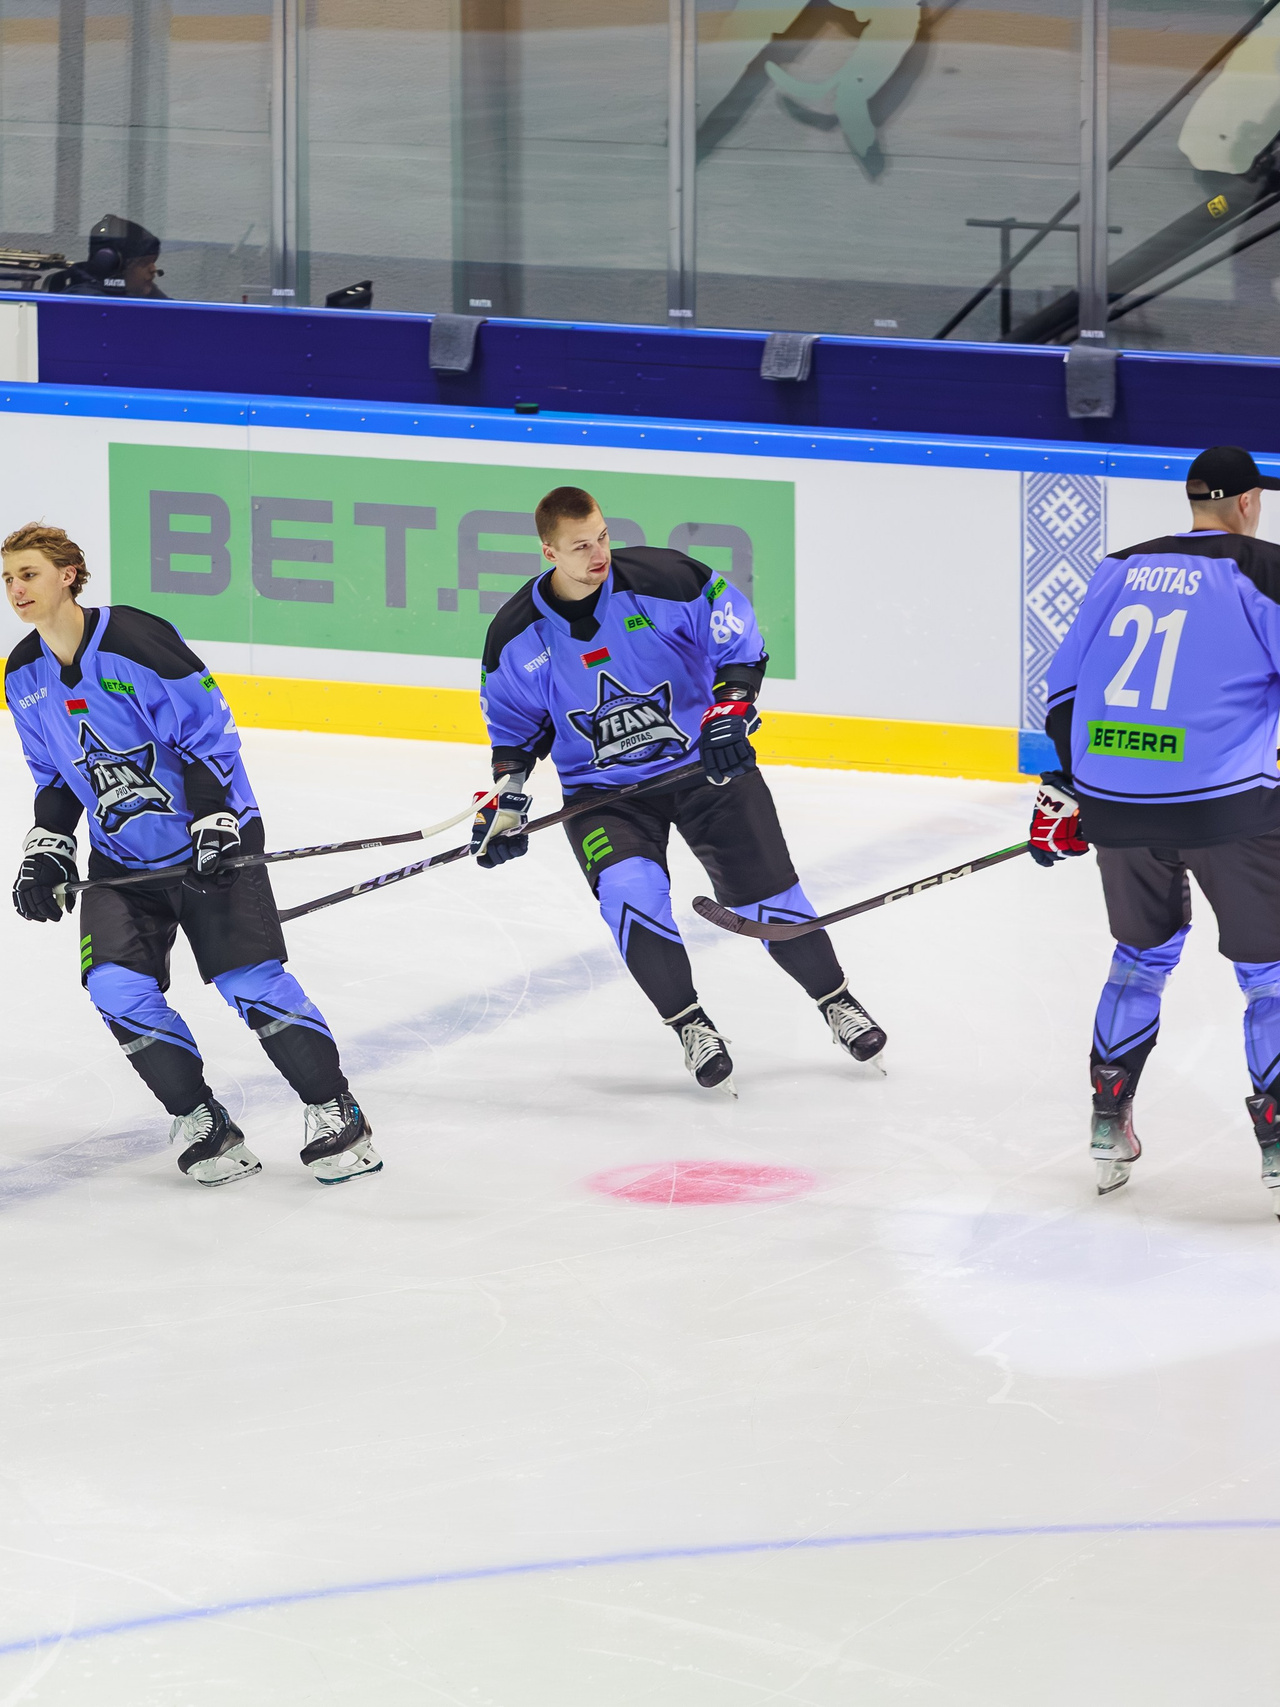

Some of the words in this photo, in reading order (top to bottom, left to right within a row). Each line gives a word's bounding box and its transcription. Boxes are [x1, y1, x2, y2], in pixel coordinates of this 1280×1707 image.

[1125, 566, 1203, 596] PROTAS
[1104, 604, 1188, 711] 21
[598, 705, 665, 742] TEAM
[620, 732, 653, 750] PROTAS
[1093, 727, 1177, 754] BETERA
[93, 765, 144, 790] TEM
[24, 837, 75, 856] CCM
[201, 853, 217, 864] CCM
[352, 857, 433, 894] CCM
